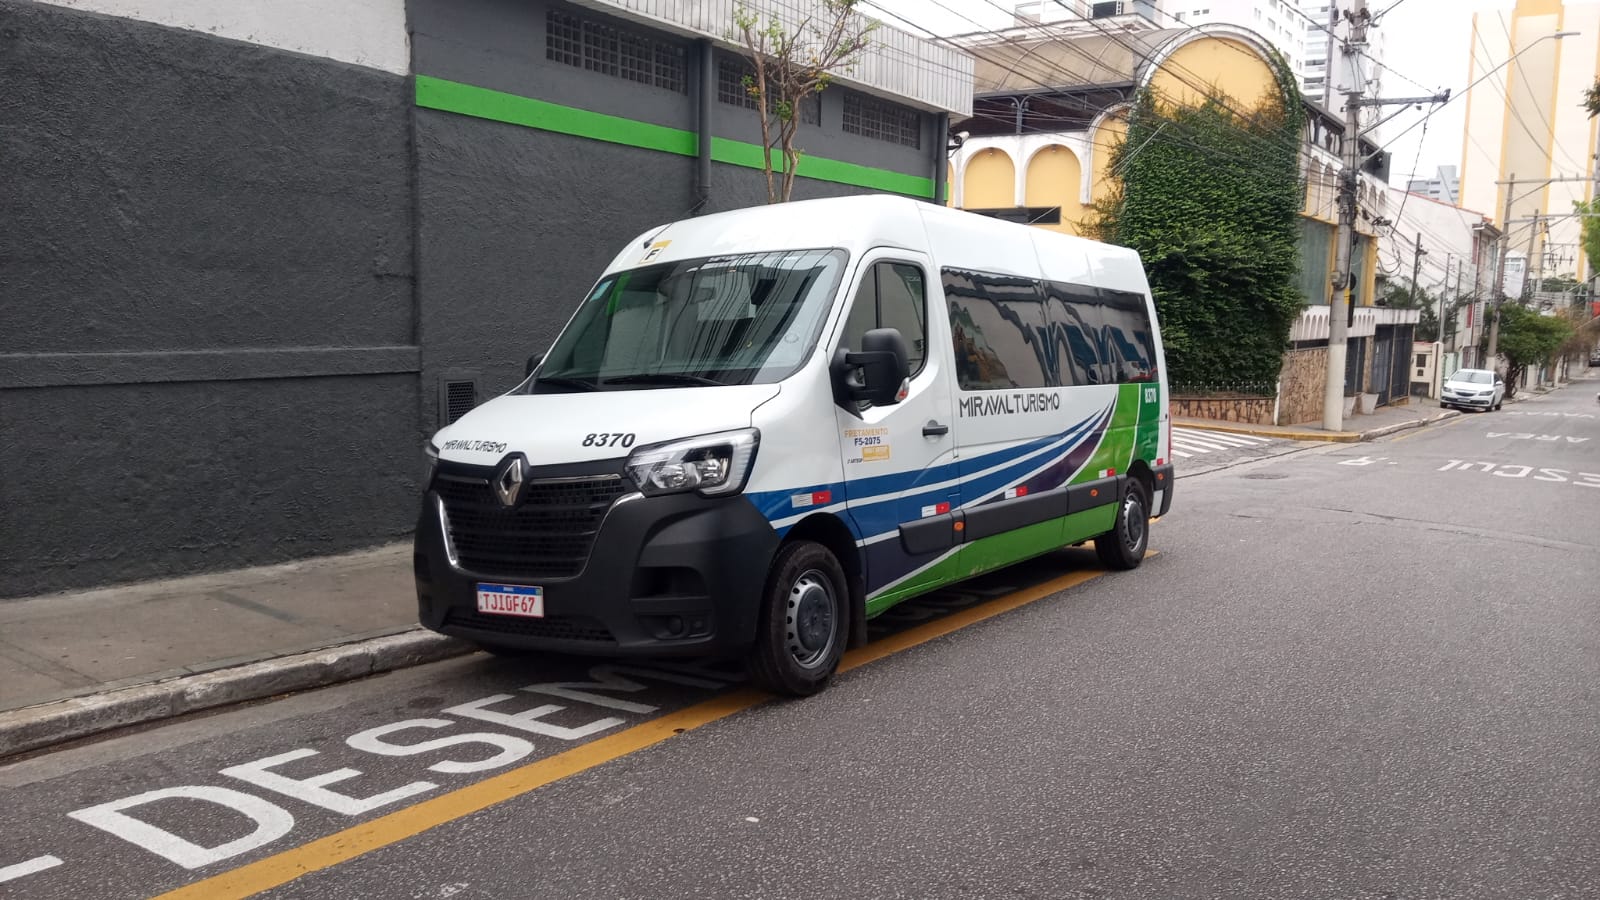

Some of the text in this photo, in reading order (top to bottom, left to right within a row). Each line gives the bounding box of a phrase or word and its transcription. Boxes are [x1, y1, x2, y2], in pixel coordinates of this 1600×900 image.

[645, 248, 660, 261] F
[582, 432, 636, 449] 8370
[854, 436, 881, 446] F5-2075
